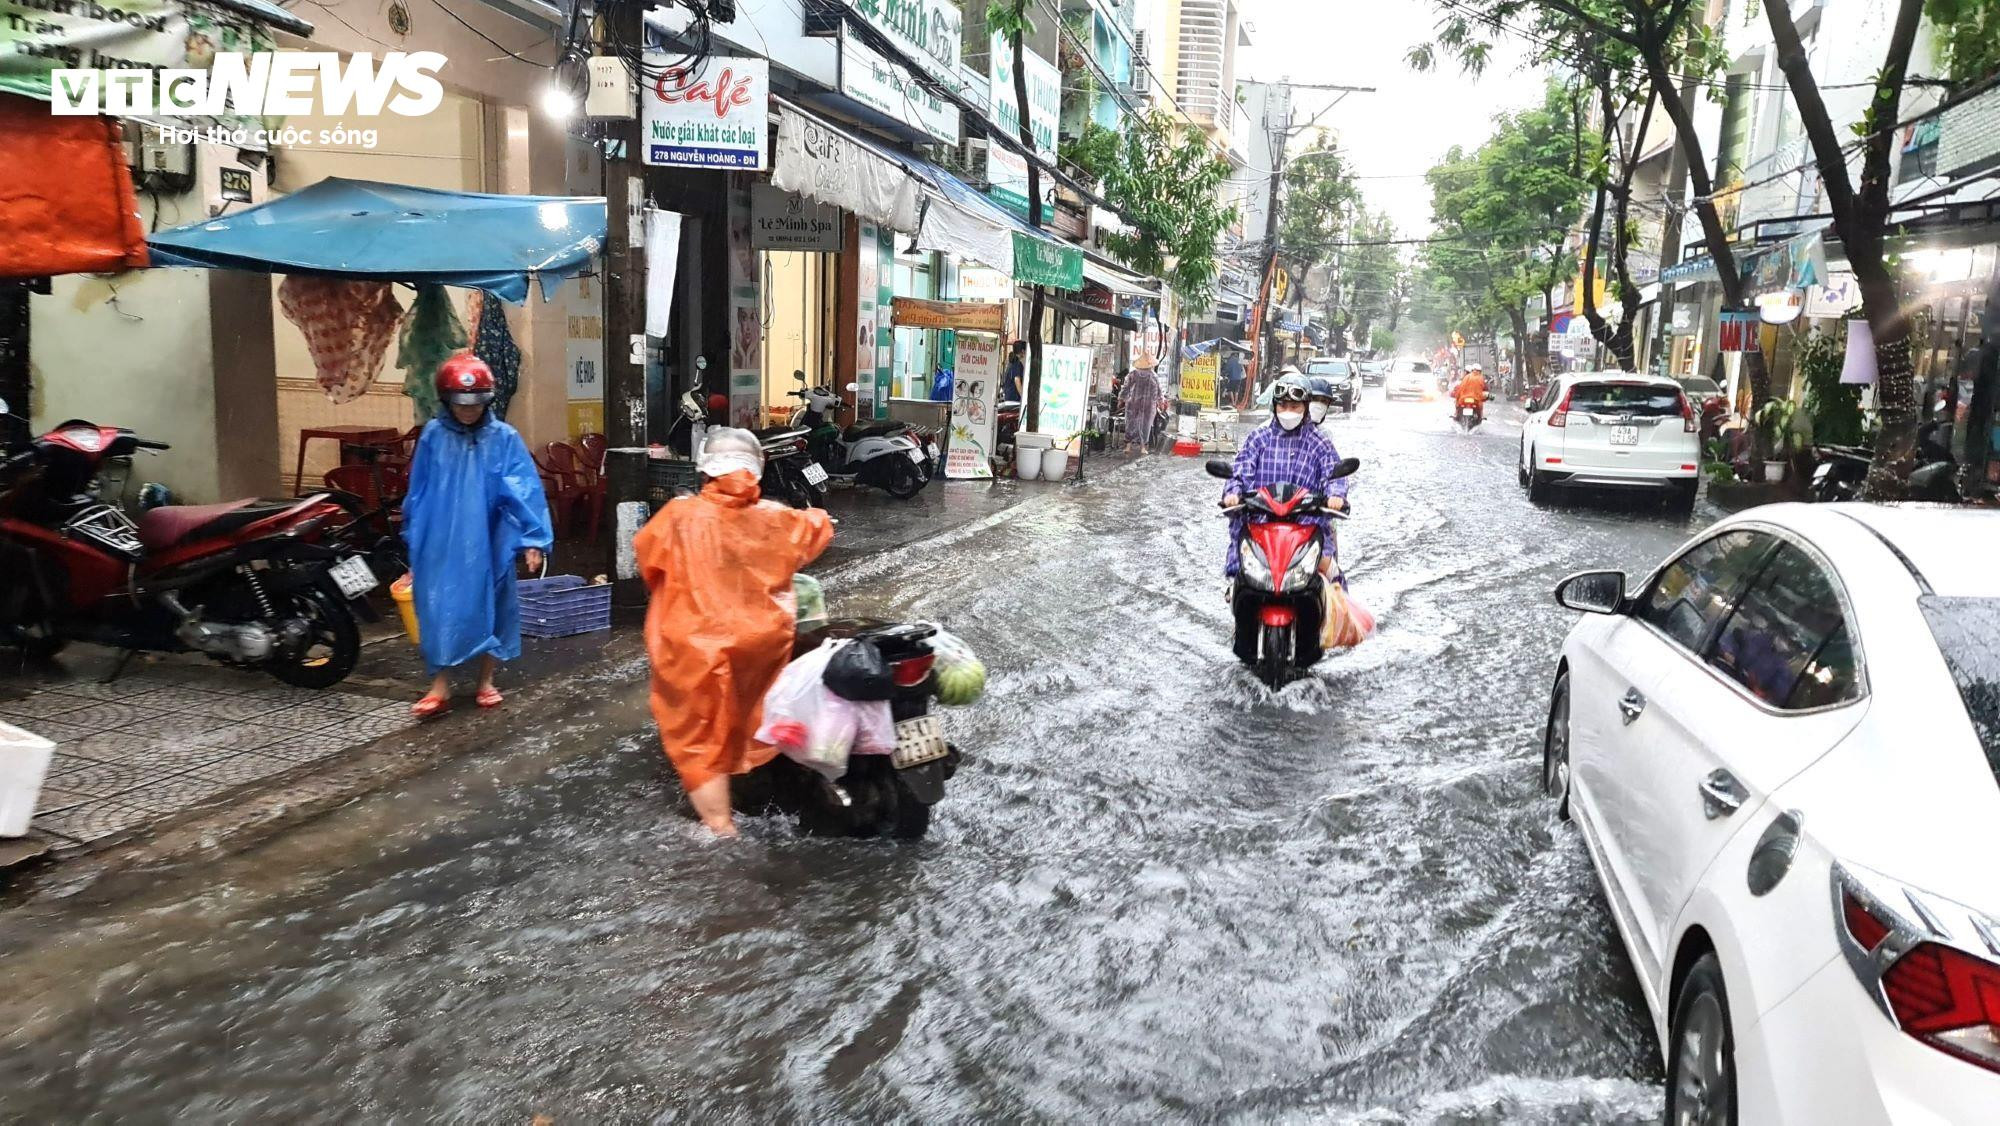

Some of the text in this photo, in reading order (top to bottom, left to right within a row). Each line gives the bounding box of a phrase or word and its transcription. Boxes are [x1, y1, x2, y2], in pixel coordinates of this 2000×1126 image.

[654, 66, 753, 119] Café
[697, 123, 719, 142] khát
[722, 124, 736, 144] các
[738, 126, 756, 149] loại
[654, 151, 669, 160] 278
[707, 152, 736, 165] HOÀNG
[743, 156, 756, 166] ĐN
[223, 171, 250, 191] 278
[810, 218, 832, 233] Spa
[584, 360, 595, 383] HOA
